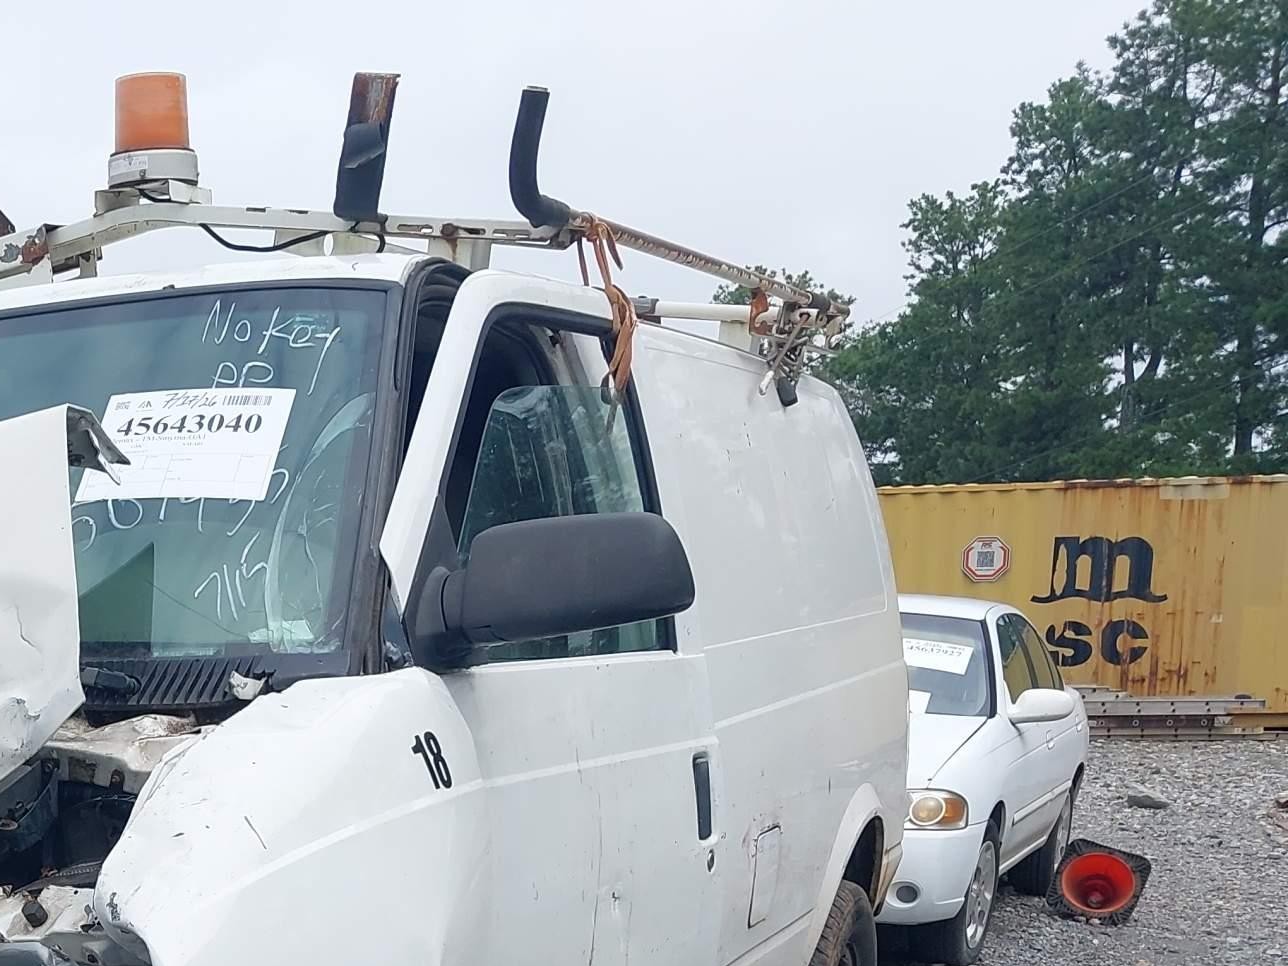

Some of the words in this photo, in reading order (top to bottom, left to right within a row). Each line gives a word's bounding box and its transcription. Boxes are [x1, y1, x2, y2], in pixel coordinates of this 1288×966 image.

[201, 299, 252, 345] No
[116, 412, 263, 437] 45643040
[410, 730, 453, 790] 18
